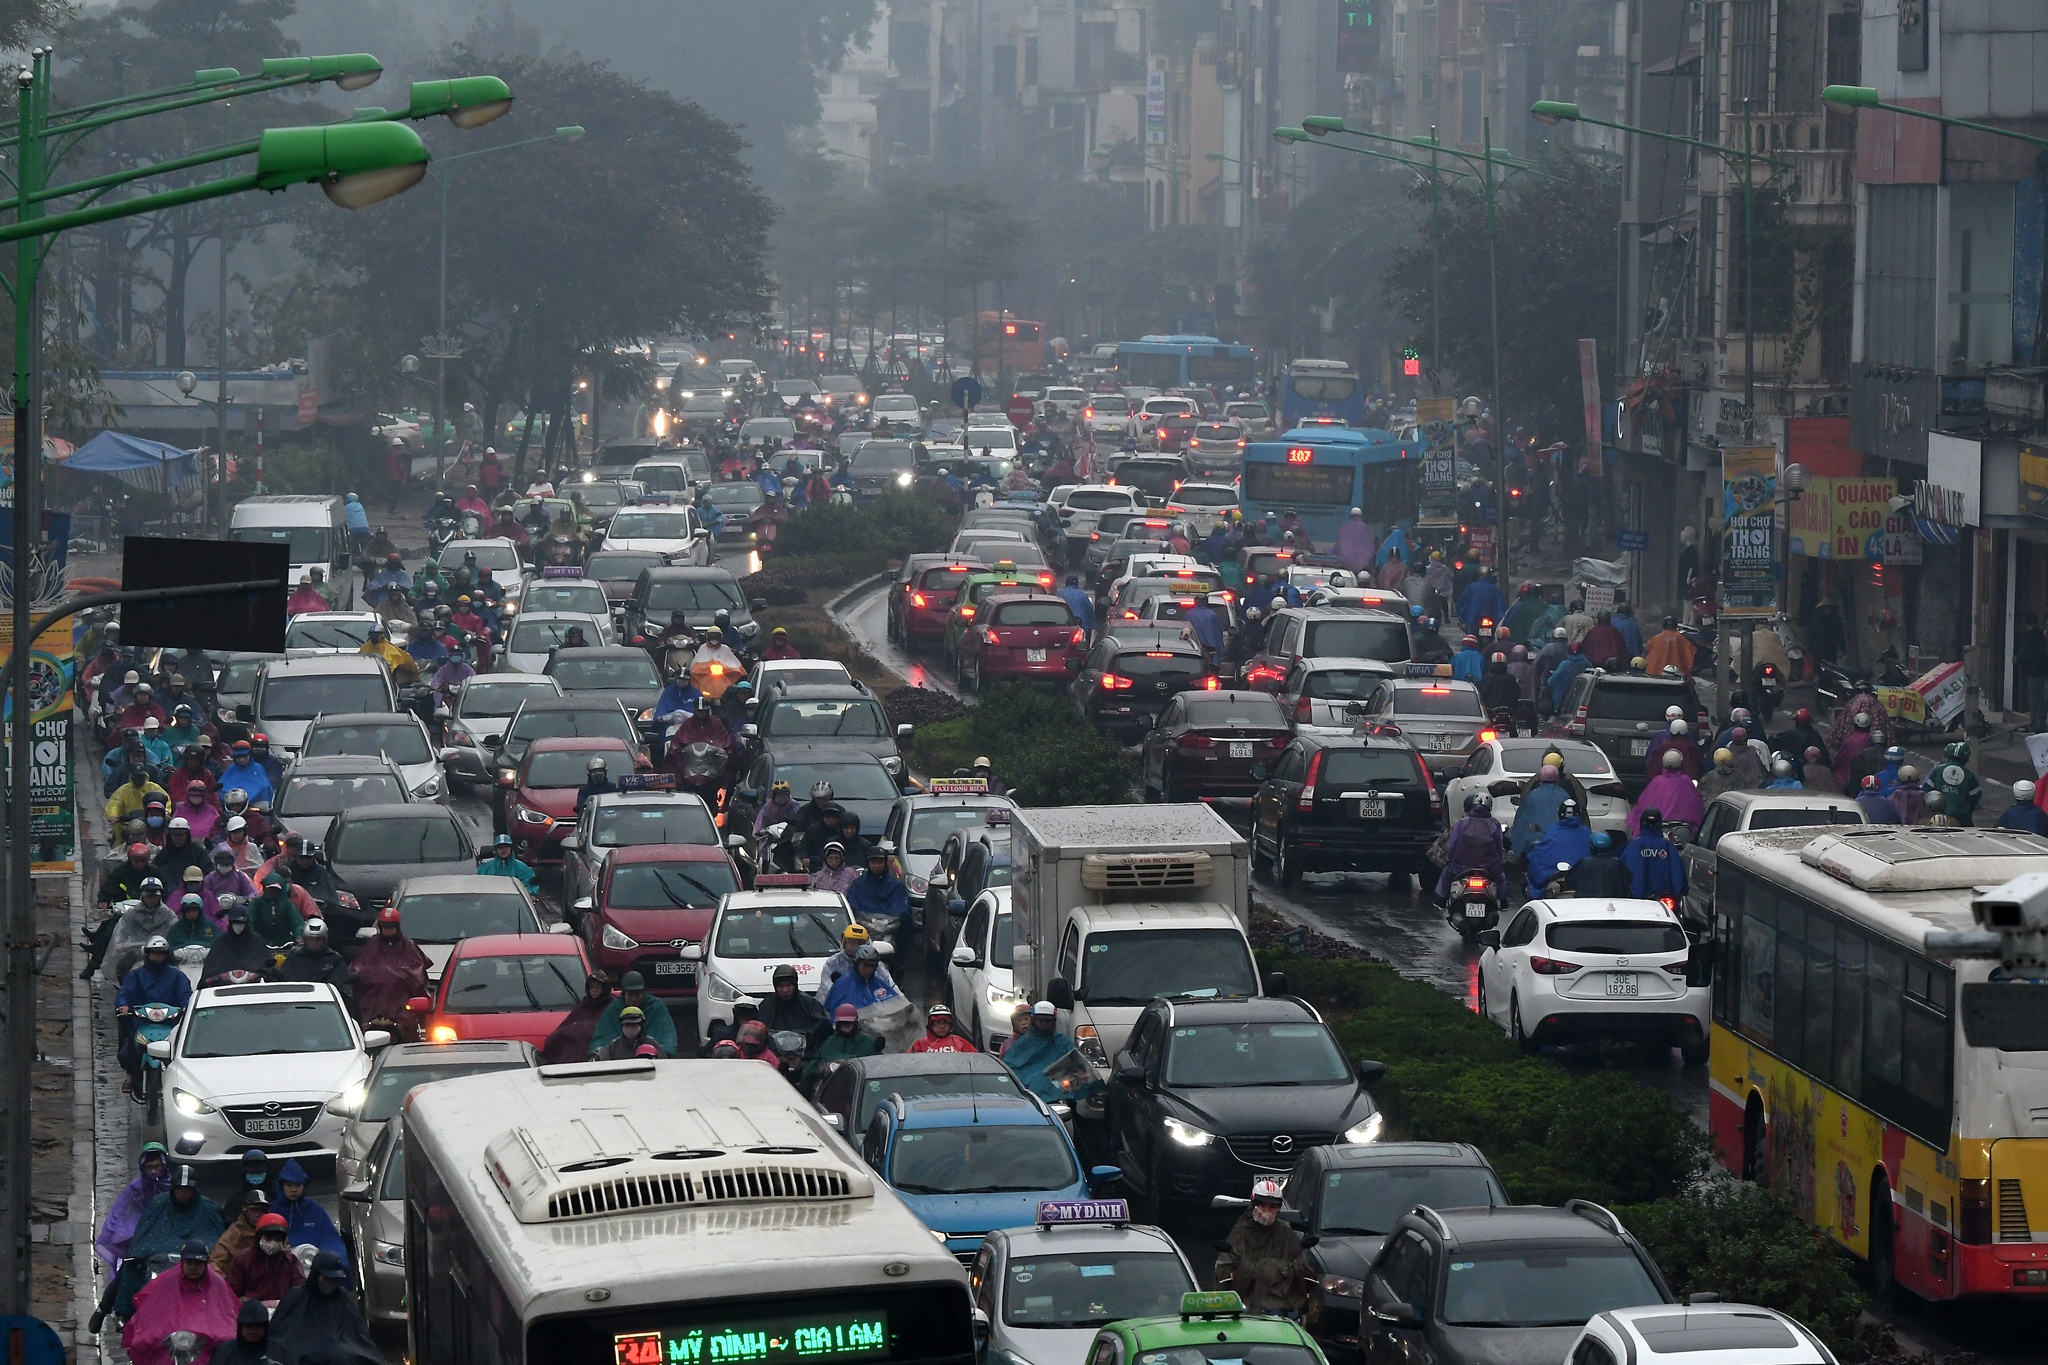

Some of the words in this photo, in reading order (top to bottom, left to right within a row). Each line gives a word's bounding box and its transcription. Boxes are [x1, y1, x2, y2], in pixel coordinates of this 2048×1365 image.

[1288, 450, 1311, 462] 107
[1424, 473, 1453, 482] TRANG
[1837, 480, 1893, 506] QUẢNG
[1730, 515, 1748, 528] HỘI
[1750, 515, 1771, 528] CHỢ
[1848, 507, 1882, 529] CÁO
[1731, 526, 1770, 546] THỜI
[1730, 545, 1770, 559] TRANG
[1837, 537, 1859, 555] IN
[1407, 665, 1431, 674] VINA
[35, 720, 68, 740] CHỢ
[1435, 734, 1447, 742] 30E
[47, 787, 67, 796] 2017
[1941, 785, 1959, 795] Grab
[1365, 801, 1380, 809] 30Y
[1362, 808, 1383, 817] 6068
[1613, 975, 1630, 983] 30E
[246, 1119, 300, 1132] 30E-615.93
[1059, 1203, 1083, 1219] MỸ
[1082, 1203, 1122, 1219] ĐÌNH
[1187, 1296, 1223, 1308] open
[669, 1329, 704, 1365] MỸ
[710, 1328, 767, 1363] ĐÌNH
[795, 1325, 832, 1355] GIA
